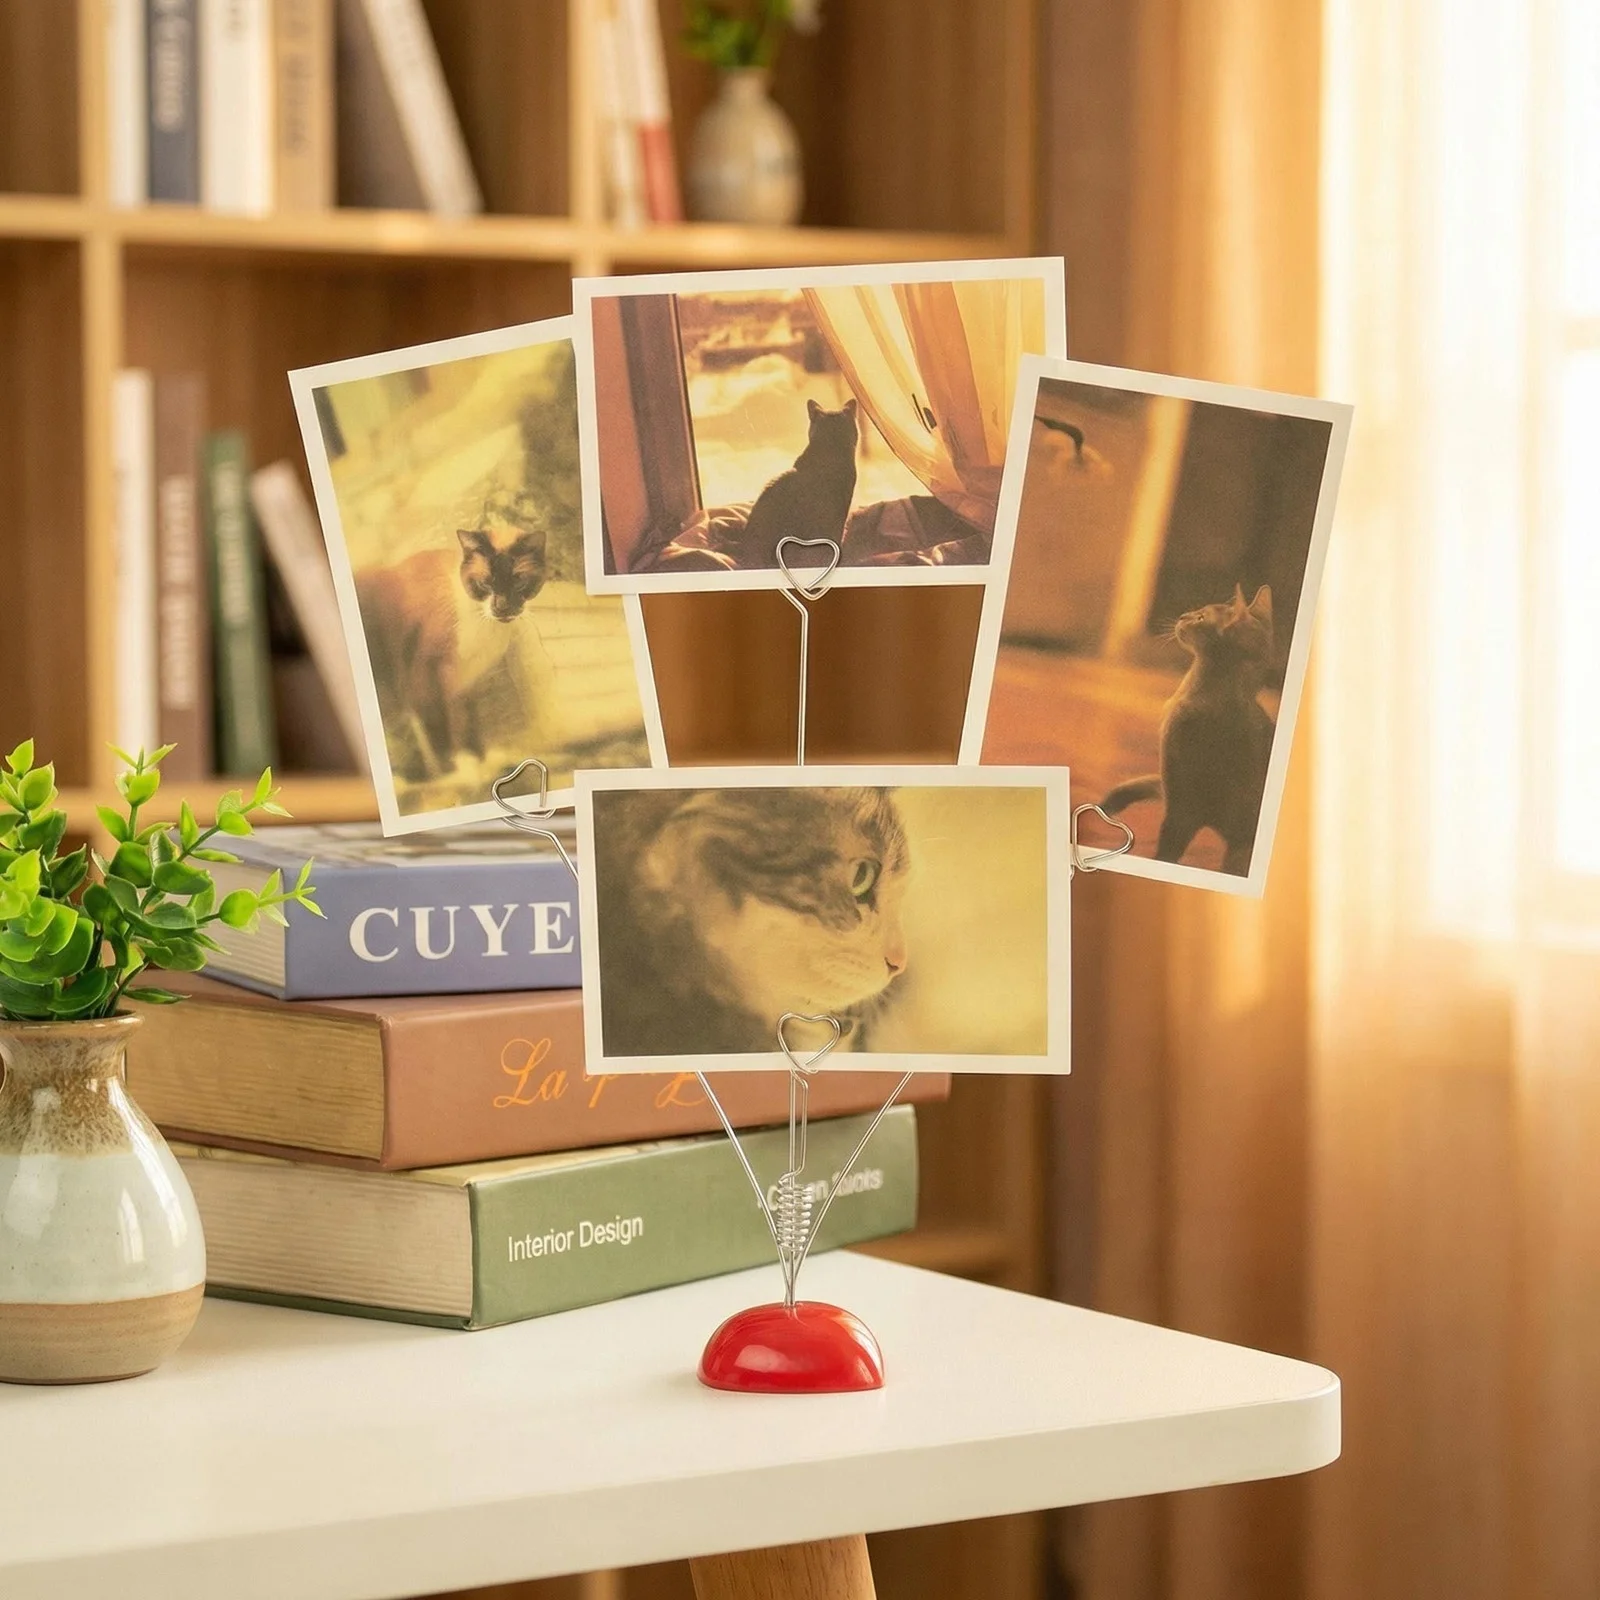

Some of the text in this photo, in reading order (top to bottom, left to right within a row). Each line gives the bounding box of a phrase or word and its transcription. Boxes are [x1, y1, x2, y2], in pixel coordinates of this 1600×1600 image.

[349, 901, 575, 963] CUYE
[493, 1038, 569, 1108] La
[508, 1215, 643, 1262] Interior Design
